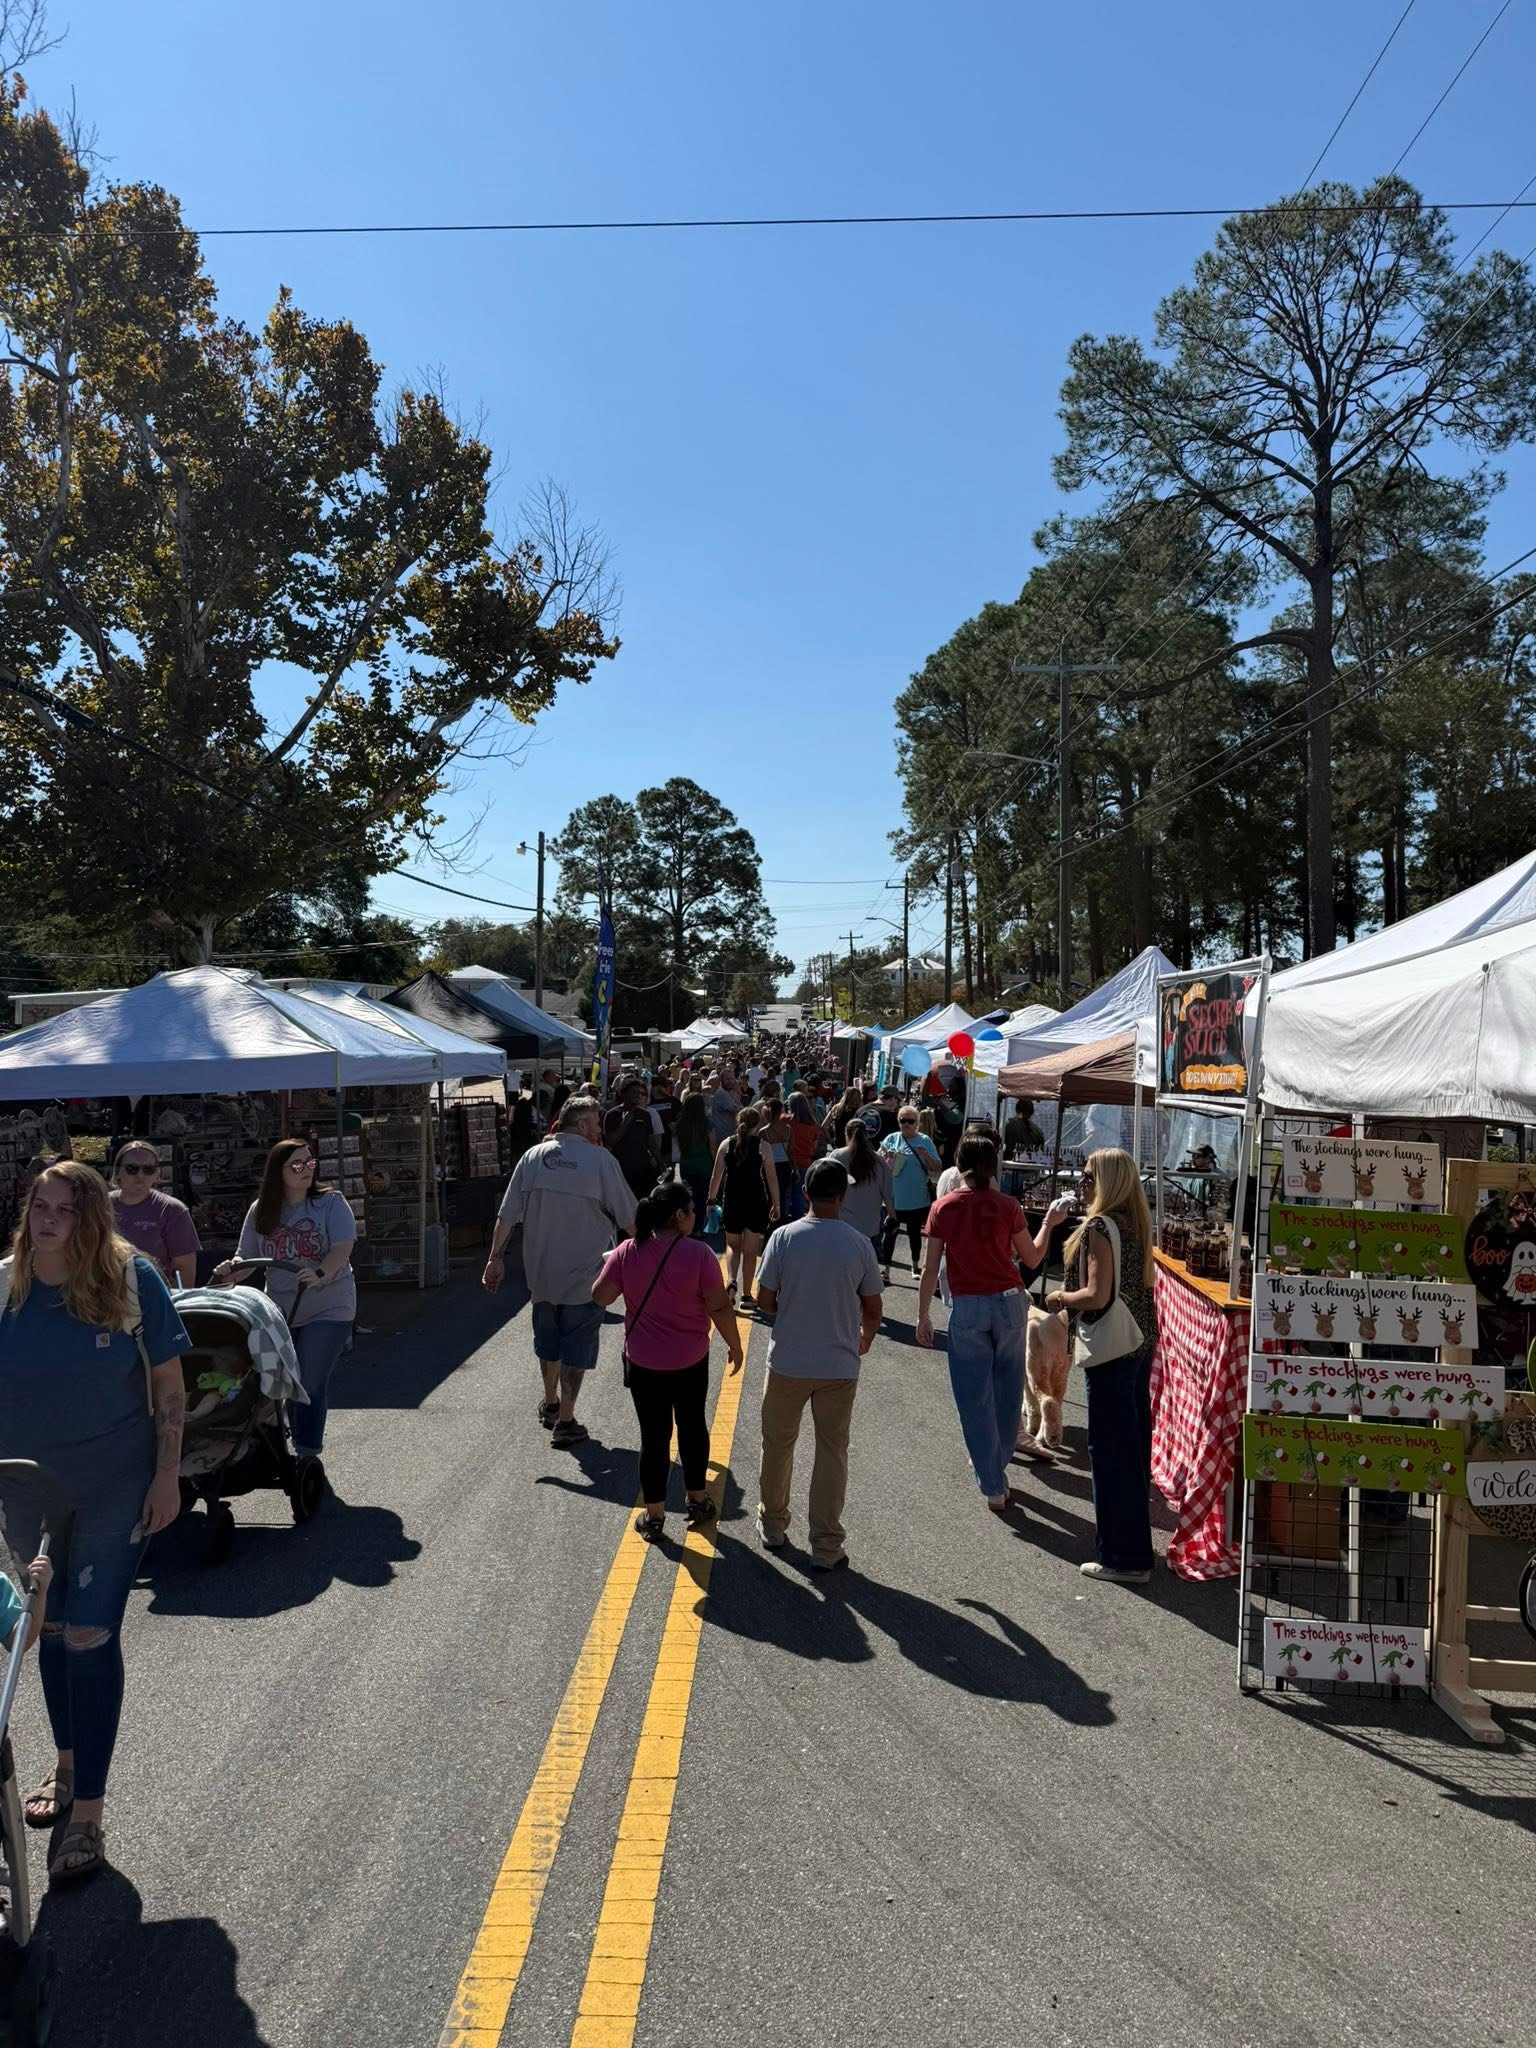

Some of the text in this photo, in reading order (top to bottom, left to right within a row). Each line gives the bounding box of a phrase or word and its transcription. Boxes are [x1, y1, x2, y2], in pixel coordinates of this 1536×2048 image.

[1291, 1138, 1311, 1153] The
[1314, 1139, 1362, 1160] stockings
[1365, 1147, 1392, 1159] were
[1279, 1209, 1307, 1227] The
[1311, 1212, 1375, 1234] stockings
[1379, 1221, 1408, 1232] were
[1266, 1278, 1296, 1295] The
[1299, 1279, 1367, 1302] stockings
[1369, 1289, 1408, 1301] were
[1266, 1358, 1303, 1376] The
[1308, 1360, 1389, 1384] stockings
[1394, 1369, 1431, 1382] were
[1254, 1420, 1286, 1438] The
[1368, 1434, 1401, 1446] were
[1272, 1622, 1297, 1640] The
[1300, 1623, 1352, 1647] stockings
[1355, 1632, 1380, 1644] were
